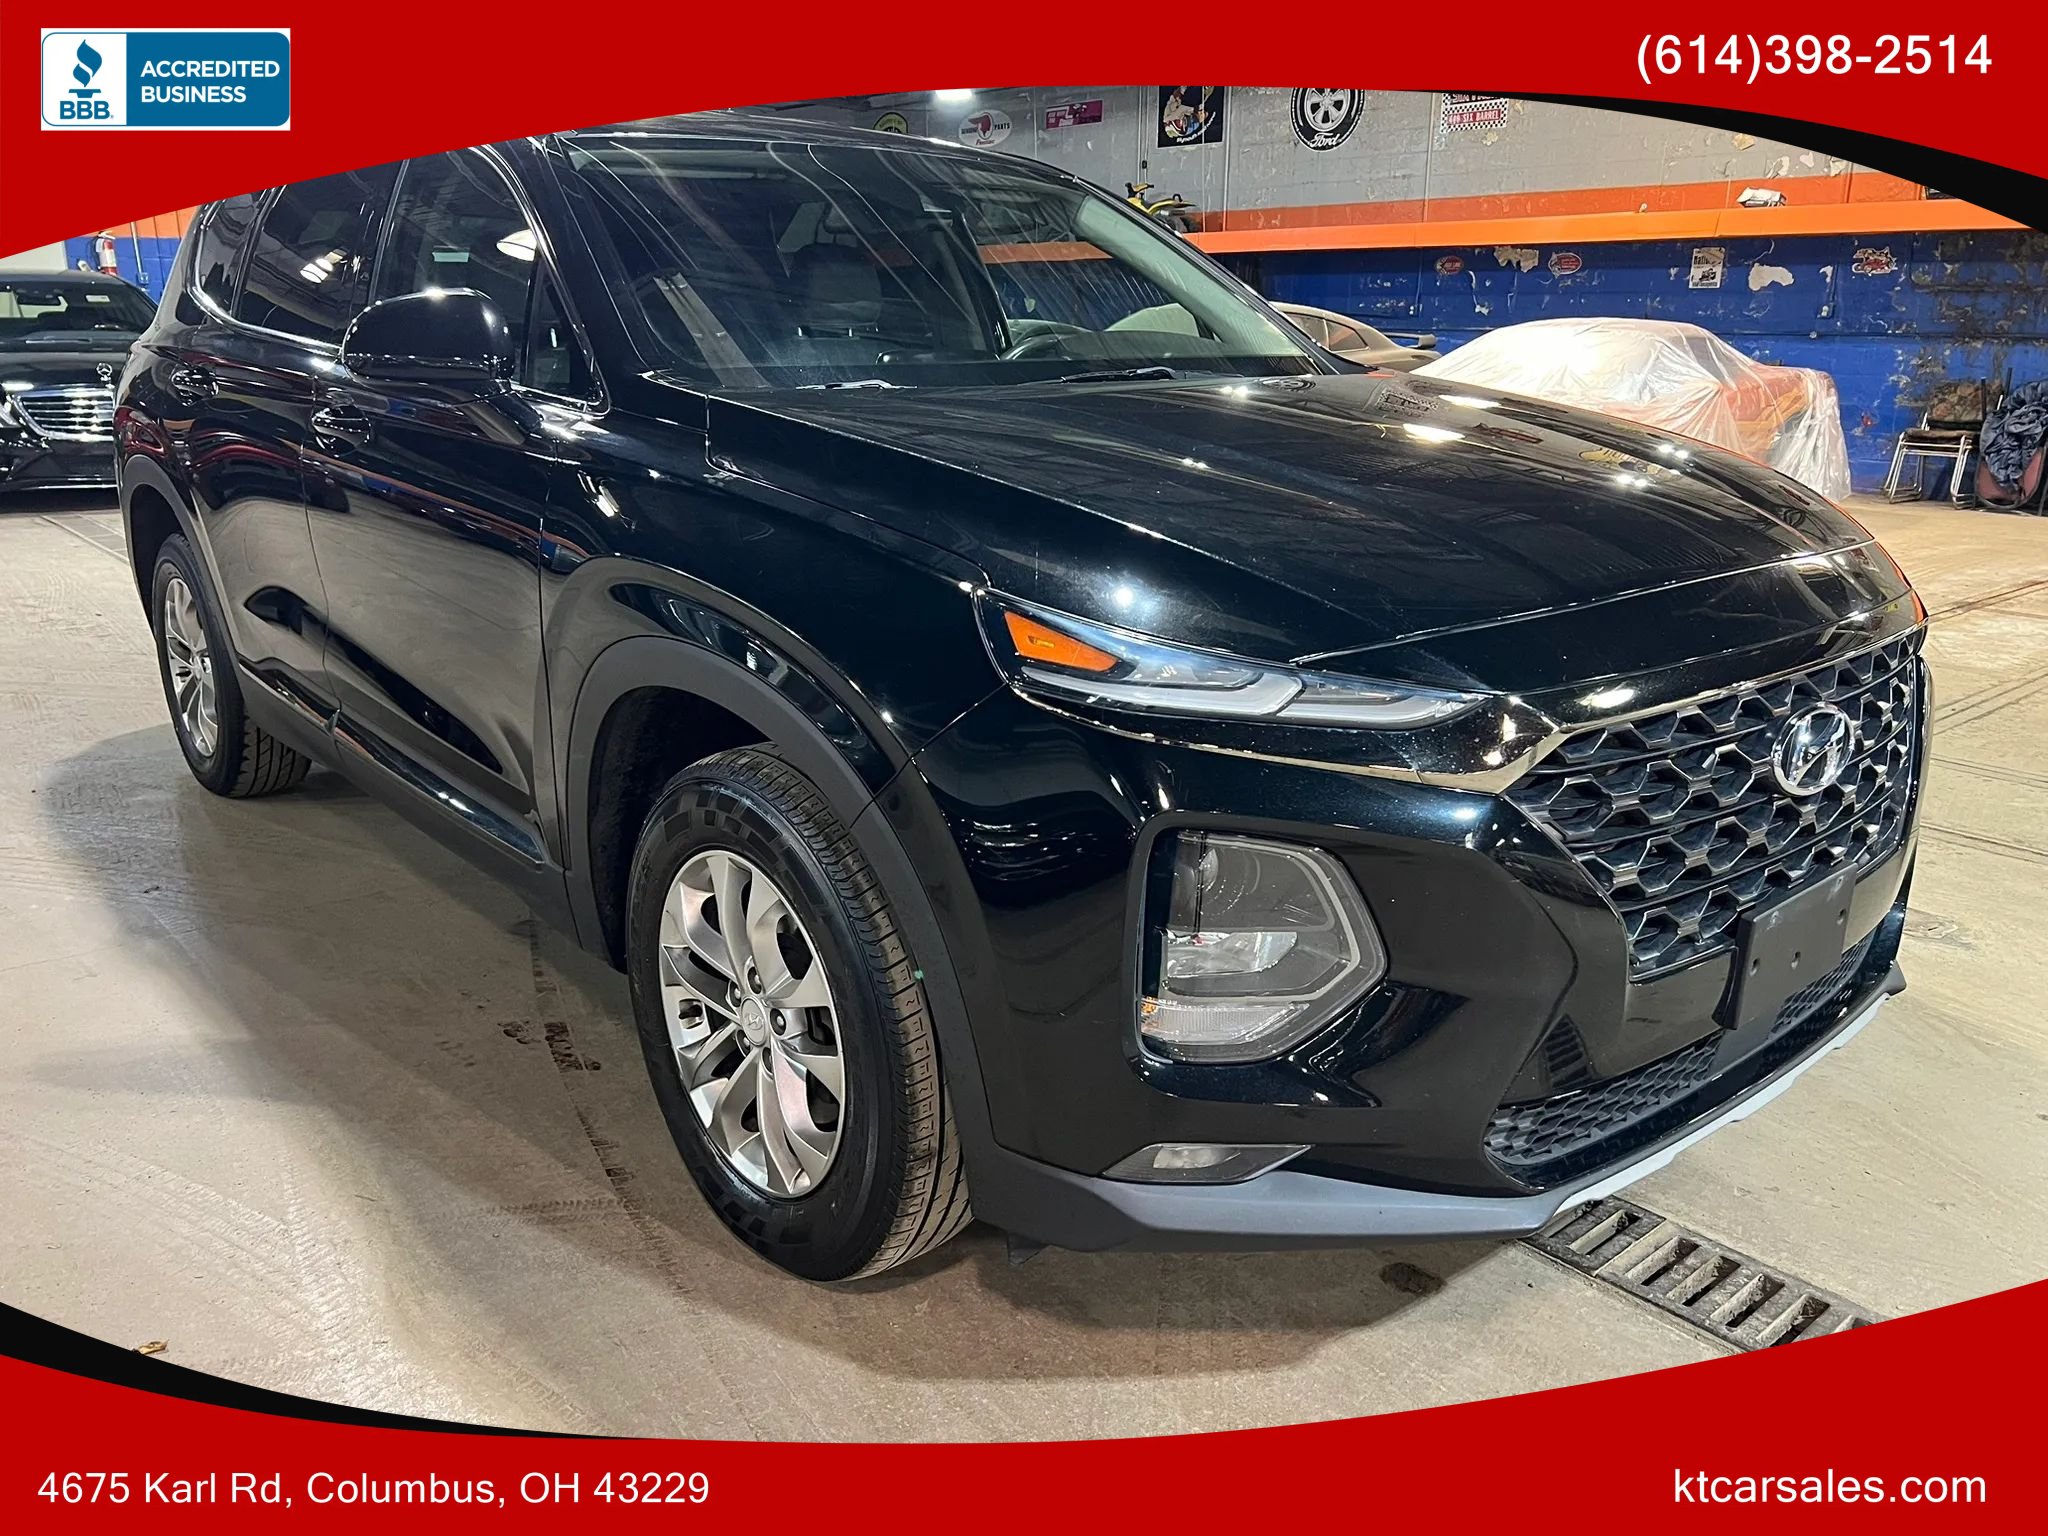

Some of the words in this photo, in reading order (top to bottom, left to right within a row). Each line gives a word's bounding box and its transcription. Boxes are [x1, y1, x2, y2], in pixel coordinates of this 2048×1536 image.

[1463, 112, 1474, 122] SIX
[1475, 110, 1500, 122] BARREL
[1309, 132, 1341, 147] Ford
